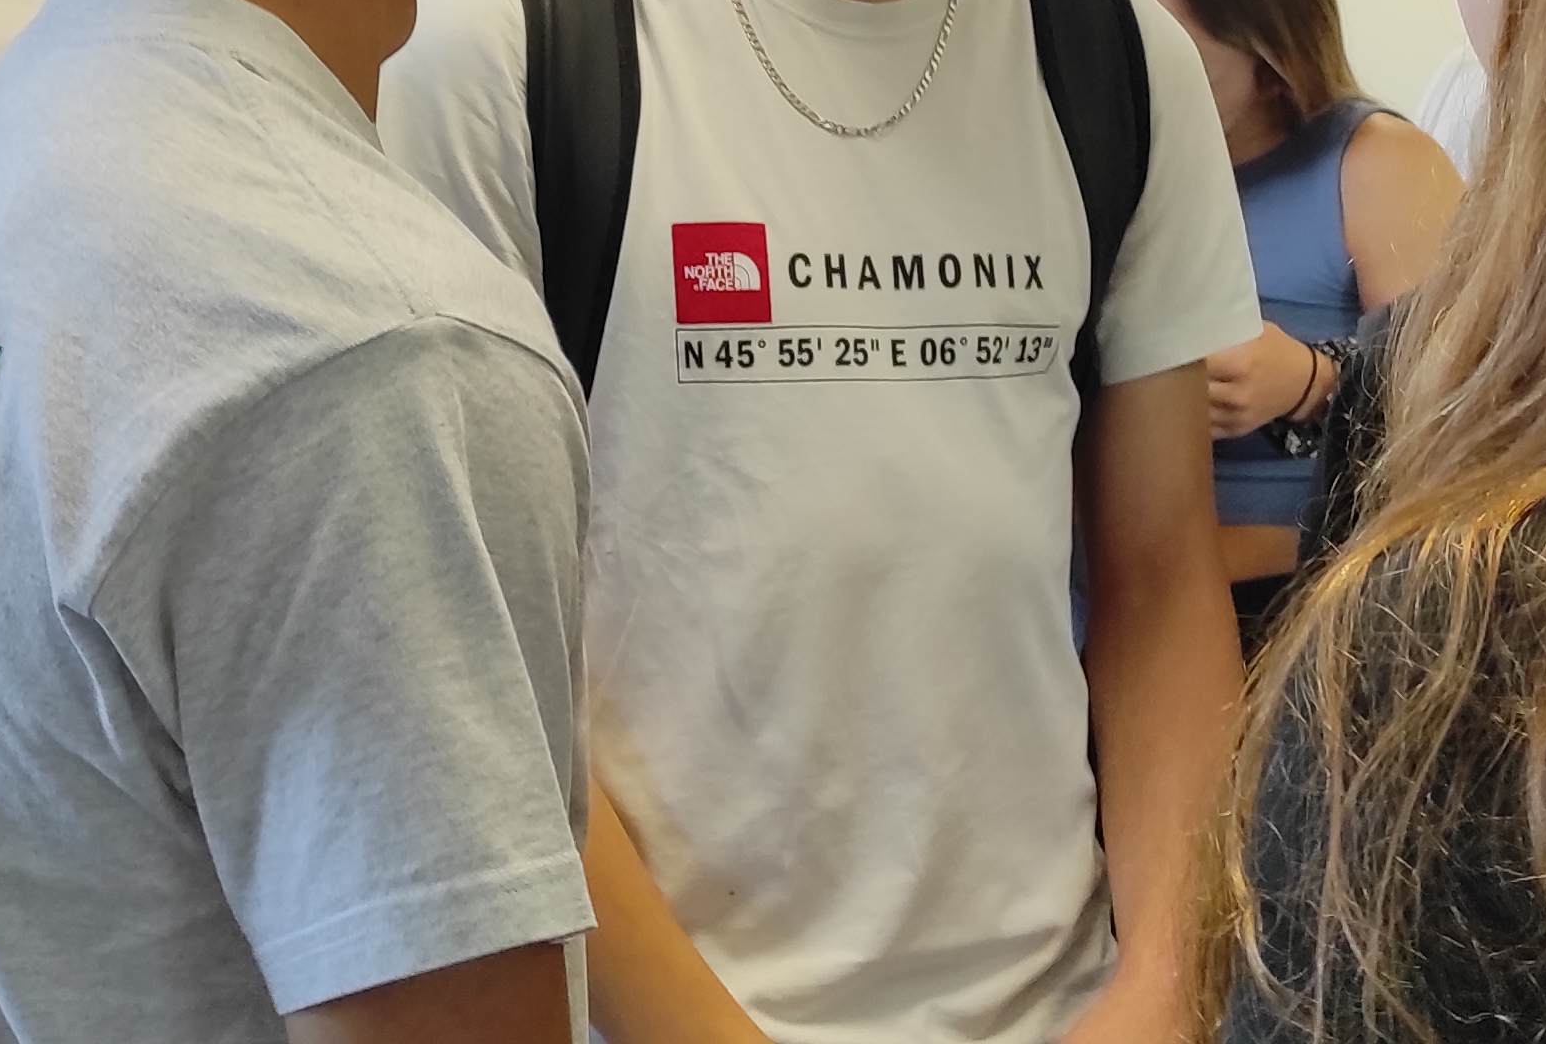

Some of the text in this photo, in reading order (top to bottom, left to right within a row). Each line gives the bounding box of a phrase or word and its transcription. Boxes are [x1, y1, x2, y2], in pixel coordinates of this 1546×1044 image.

[705, 252, 733, 266] THE
[683, 264, 734, 279] NORTH
[787, 252, 1044, 290] CHAMONIX
[698, 278, 735, 292] FACE
[684, 340, 703, 369] N
[890, 338, 907, 367] E
